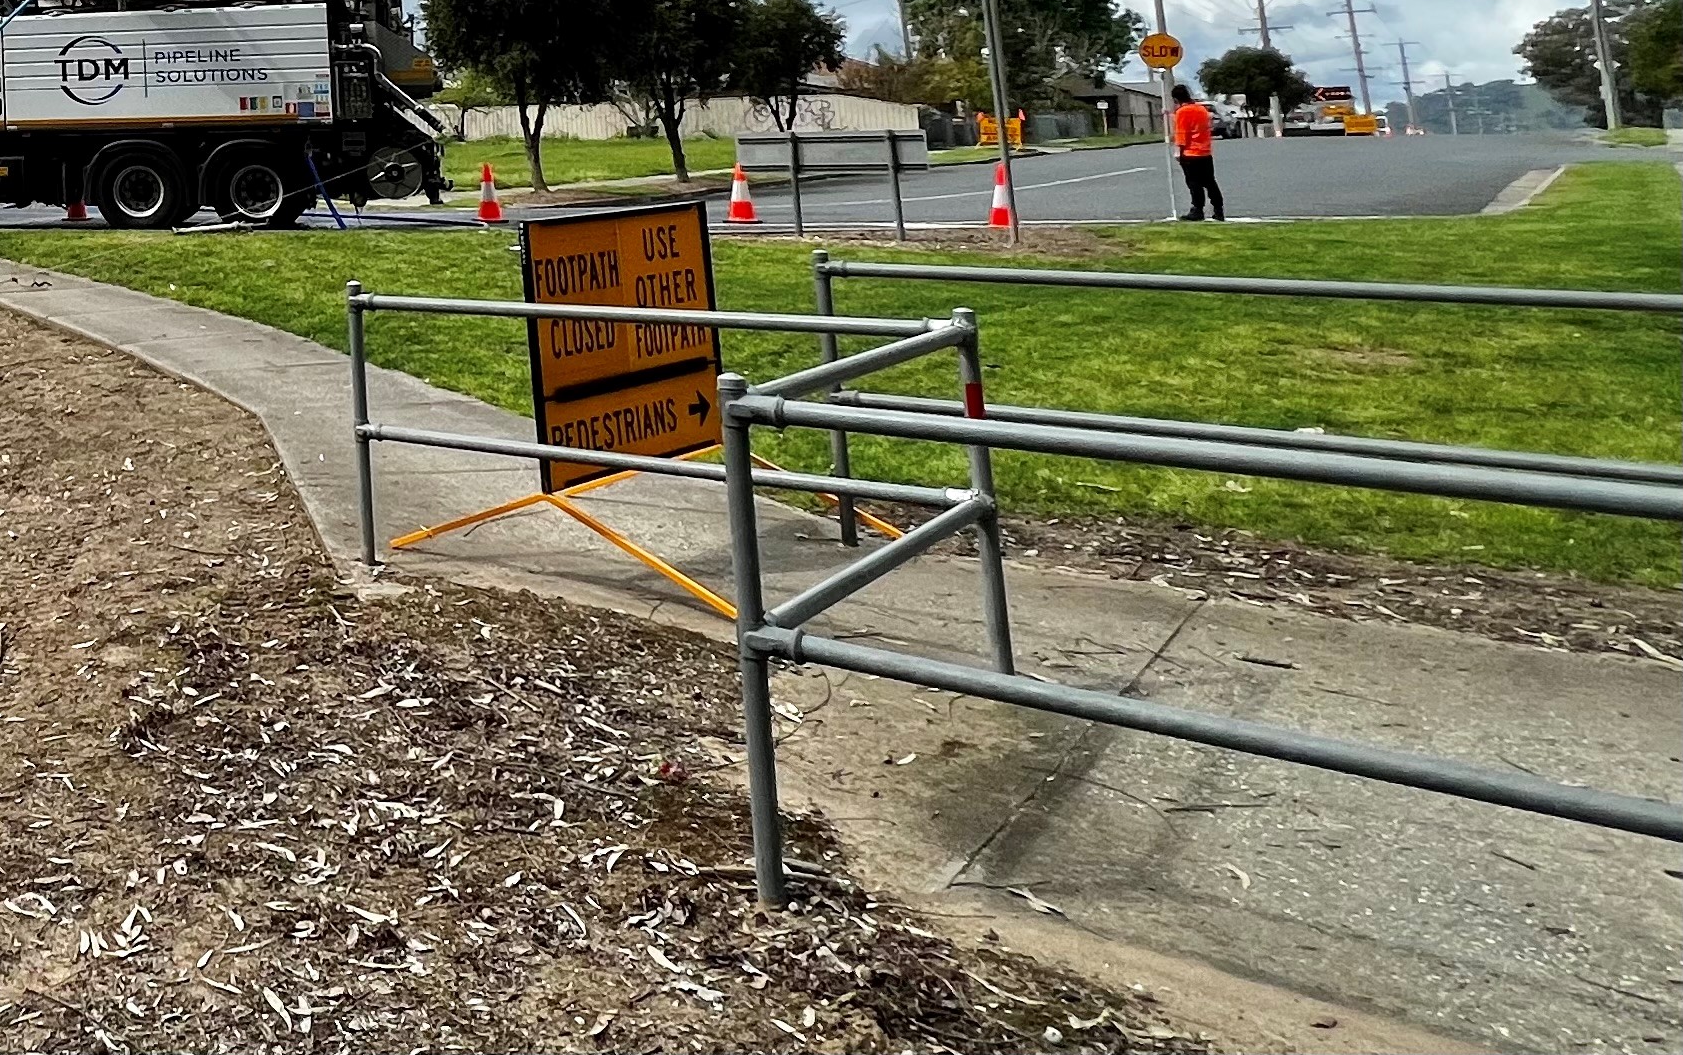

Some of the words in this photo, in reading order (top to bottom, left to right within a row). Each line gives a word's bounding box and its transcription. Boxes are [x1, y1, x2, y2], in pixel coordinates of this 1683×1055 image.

[154, 48, 241, 65] PIPELINE
[1142, 45, 1179, 58] SLOW
[54, 57, 129, 82] TDM
[155, 67, 268, 83] SOLUTIONS
[642, 224, 680, 262] USE
[534, 250, 620, 299] FOOTPATH
[635, 268, 698, 308] OTHER
[550, 319, 616, 359] CLOSED
[635, 324, 706, 359] FOOTPATH
